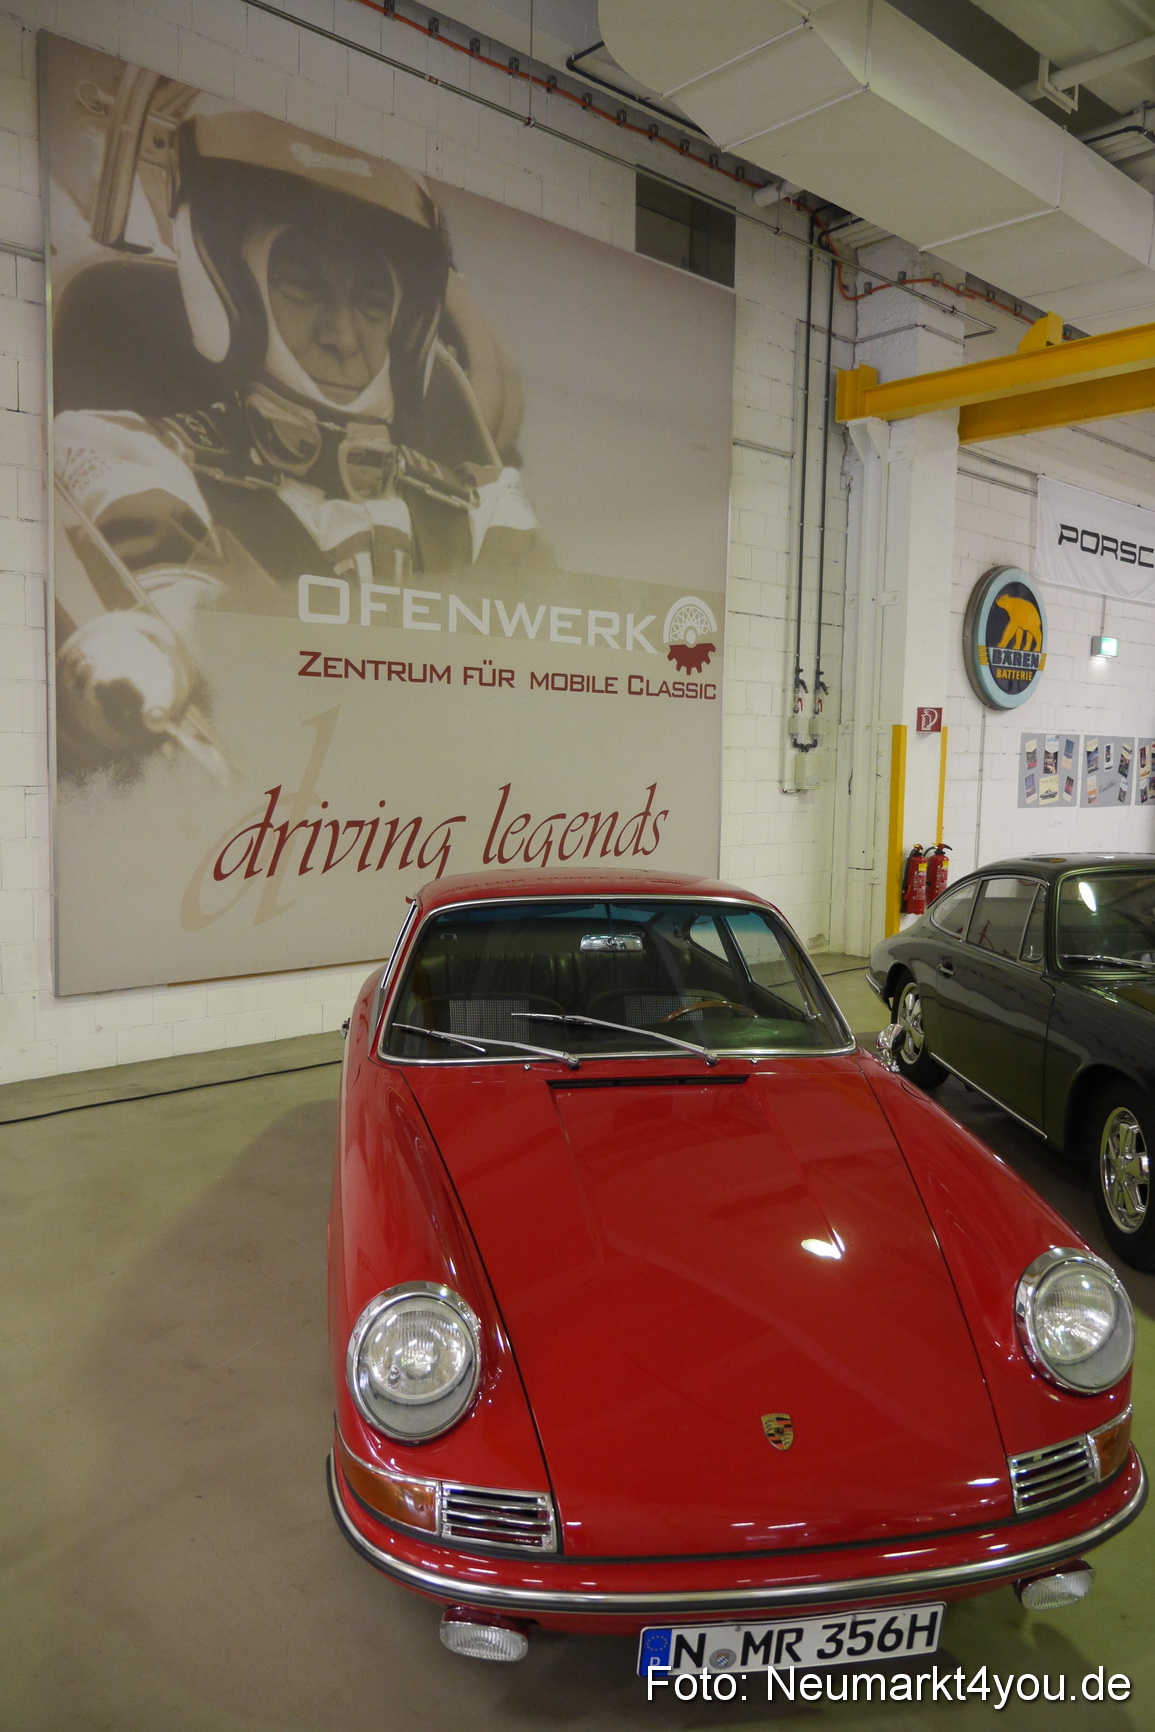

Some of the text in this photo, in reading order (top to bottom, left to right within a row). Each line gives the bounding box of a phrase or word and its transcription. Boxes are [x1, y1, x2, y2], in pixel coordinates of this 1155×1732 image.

[1058, 523, 1155, 569] PORSC
[299, 574, 660, 654] OFENWERK
[298, 650, 717, 700] ZENTRUM FÜR MOBILE CLASSIC
[992, 648, 1040, 669] BÄREN
[995, 668, 1033, 681] BATTERIE
[213, 782, 670, 882] driving legends
[673, 1612, 938, 1669] N MR 356H
